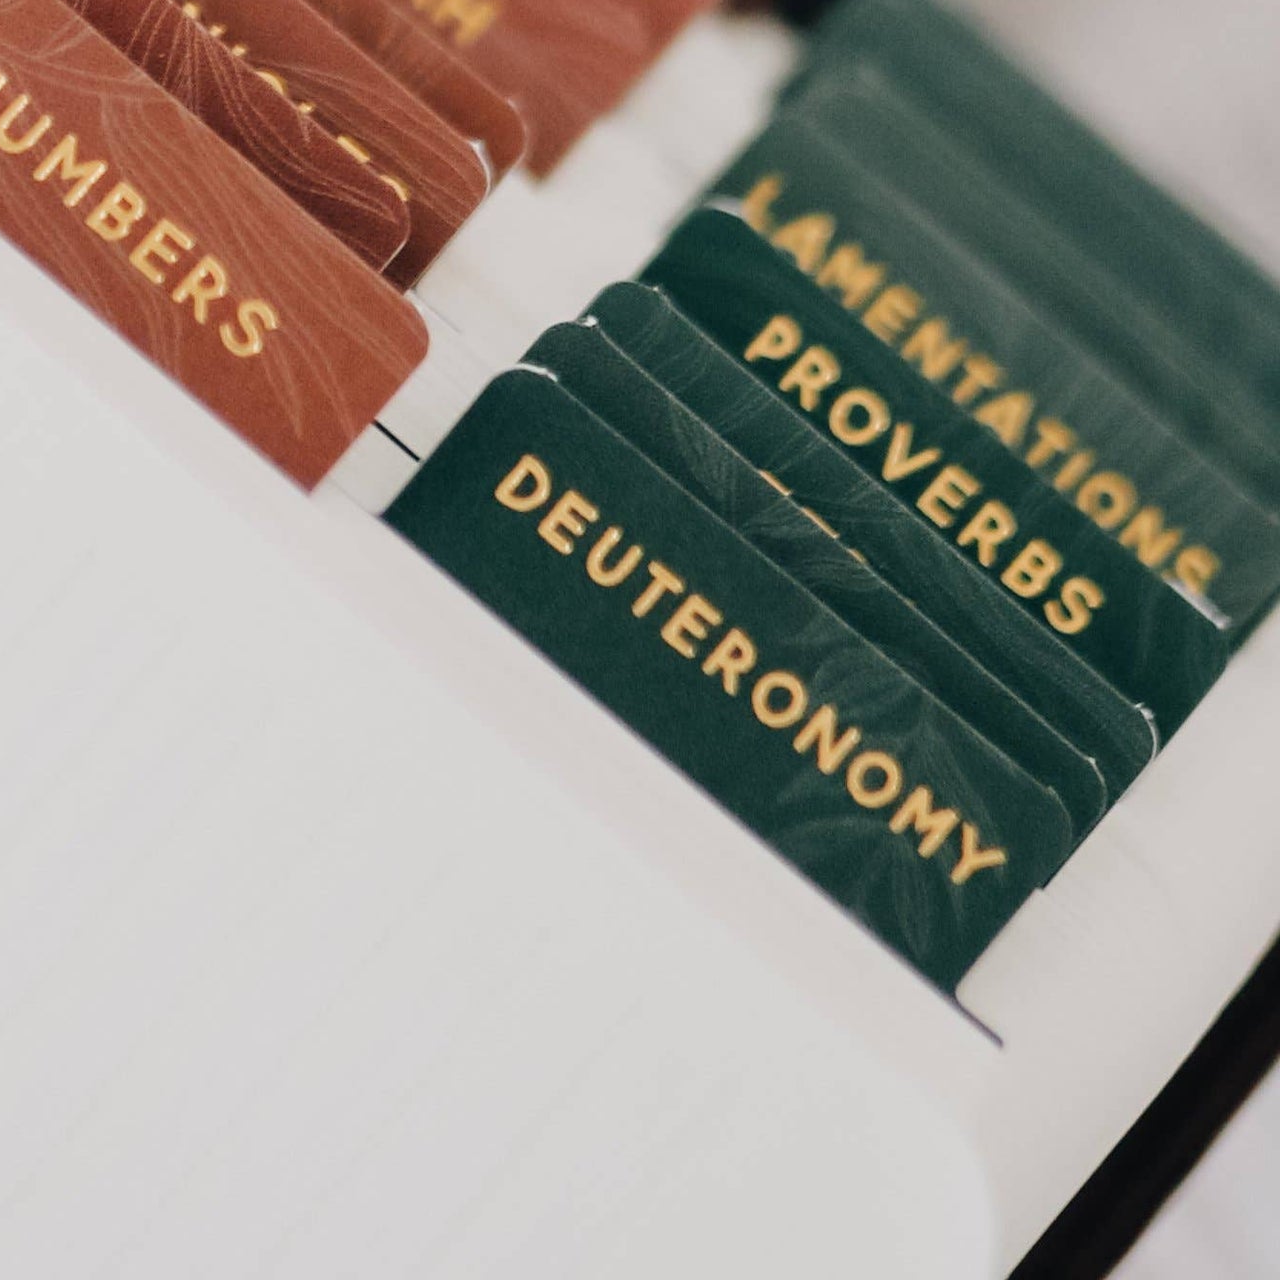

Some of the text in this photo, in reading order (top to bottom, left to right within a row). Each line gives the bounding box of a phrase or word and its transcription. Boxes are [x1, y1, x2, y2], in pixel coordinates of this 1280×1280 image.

[741, 173, 1225, 600] LAMENTATIONS
[742, 314, 1106, 637] PROVERBS
[493, 452, 1008, 886] DEUTERONOMY
